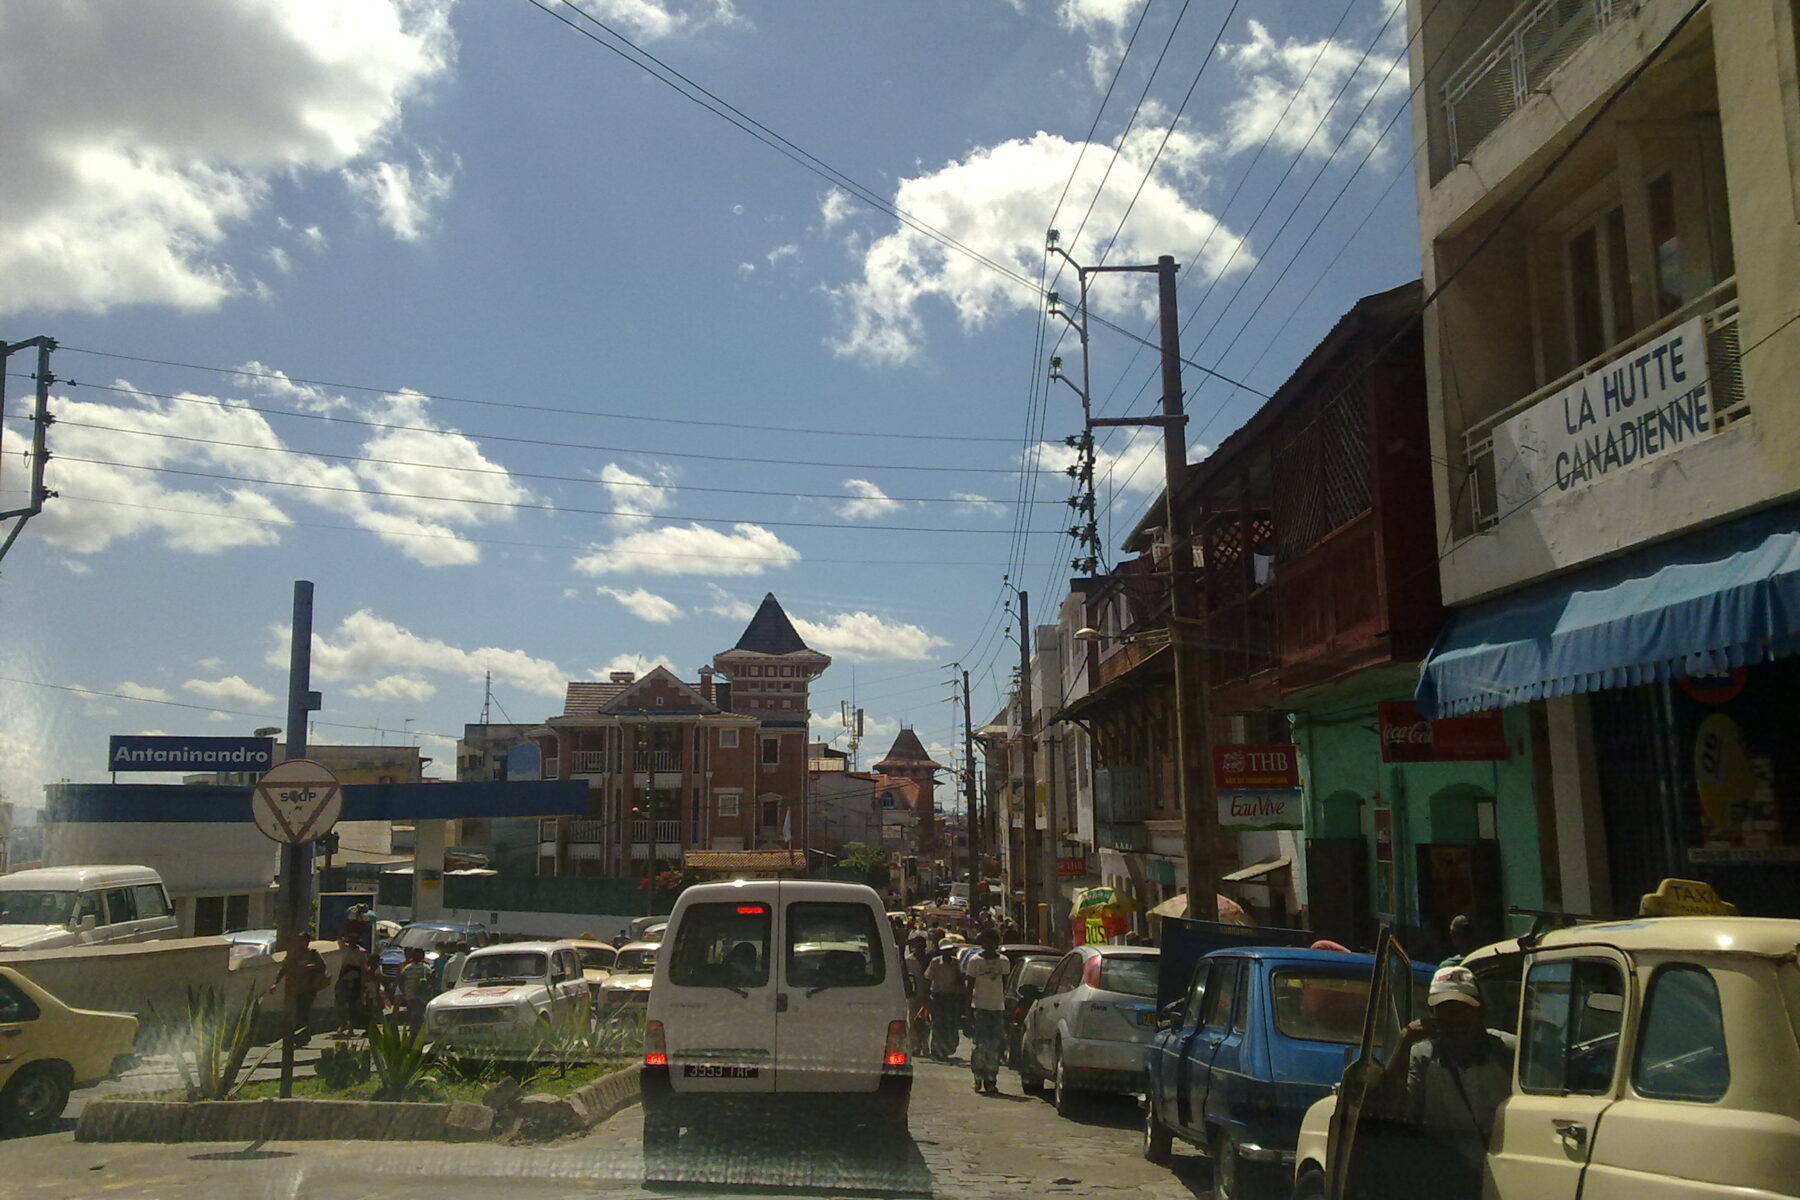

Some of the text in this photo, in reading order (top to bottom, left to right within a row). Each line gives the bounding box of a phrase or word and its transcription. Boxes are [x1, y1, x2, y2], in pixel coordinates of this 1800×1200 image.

[1564, 337, 1687, 435] LA HUTTE
[1556, 386, 1710, 491] CANADIENNE
[114, 746, 269, 763] Antaninandro
[1247, 752, 1289, 772] THB
[280, 792, 317, 802] SOP
[1671, 886, 1716, 905] TAXI
